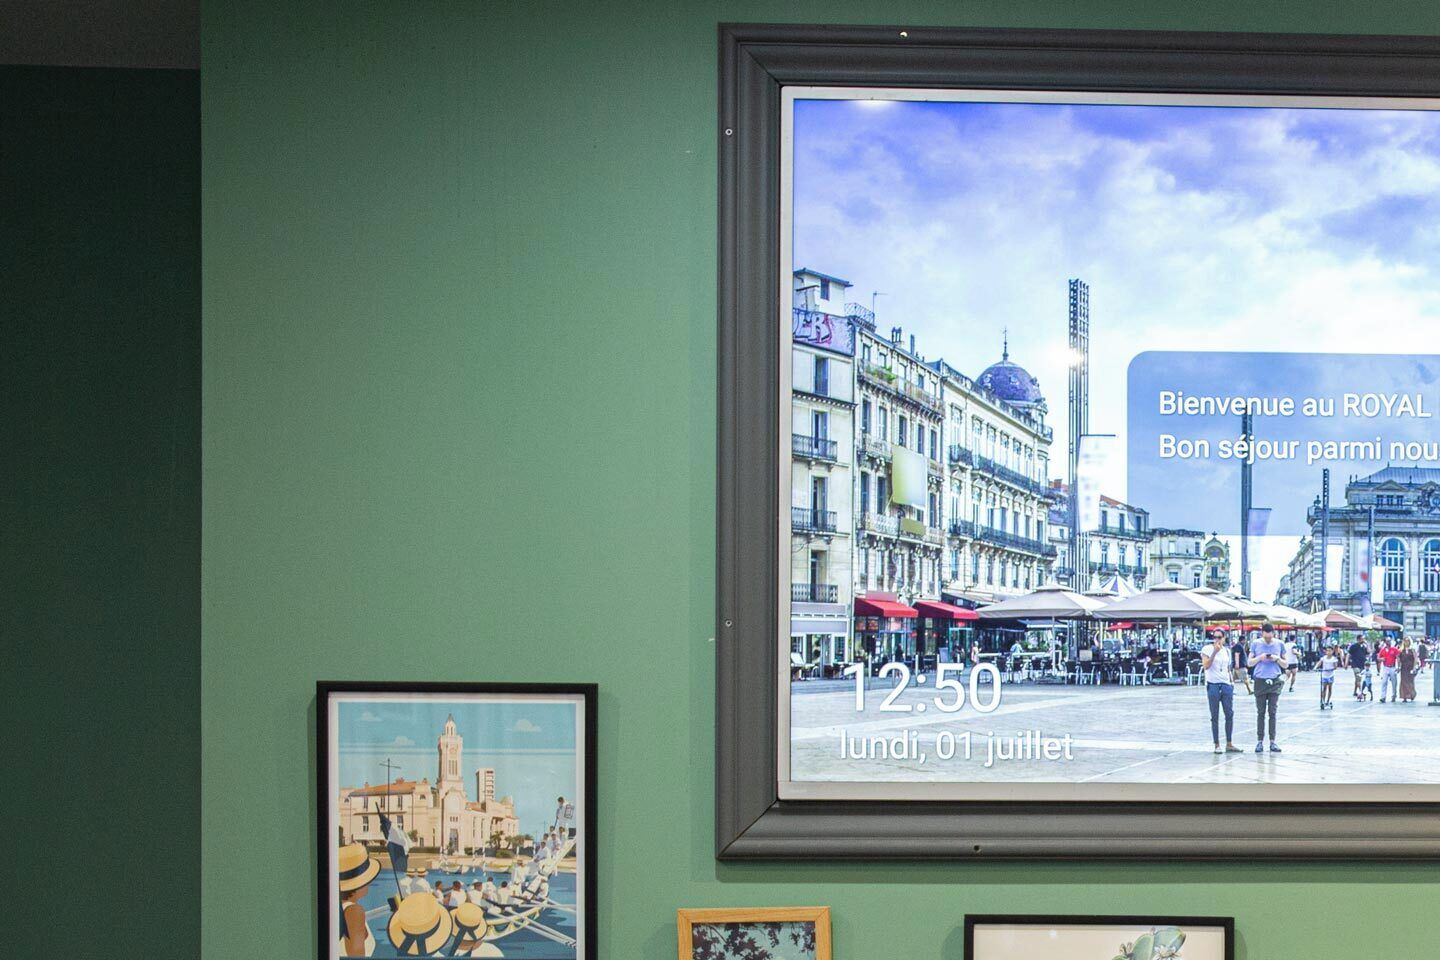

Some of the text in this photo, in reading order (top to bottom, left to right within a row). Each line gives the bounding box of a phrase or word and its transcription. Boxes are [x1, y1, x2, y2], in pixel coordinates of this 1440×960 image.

[1159, 391, 1295, 416] Bienvenue
[1302, 396, 1335, 417] au
[1343, 393, 1432, 418] ROYAL
[1159, 434, 1210, 459] Bon
[1218, 434, 1300, 466] séjour
[1307, 436, 1382, 464] parmi
[843, 661, 1003, 713] 12:50
[840, 729, 1075, 768] lundi, 01 juillet
